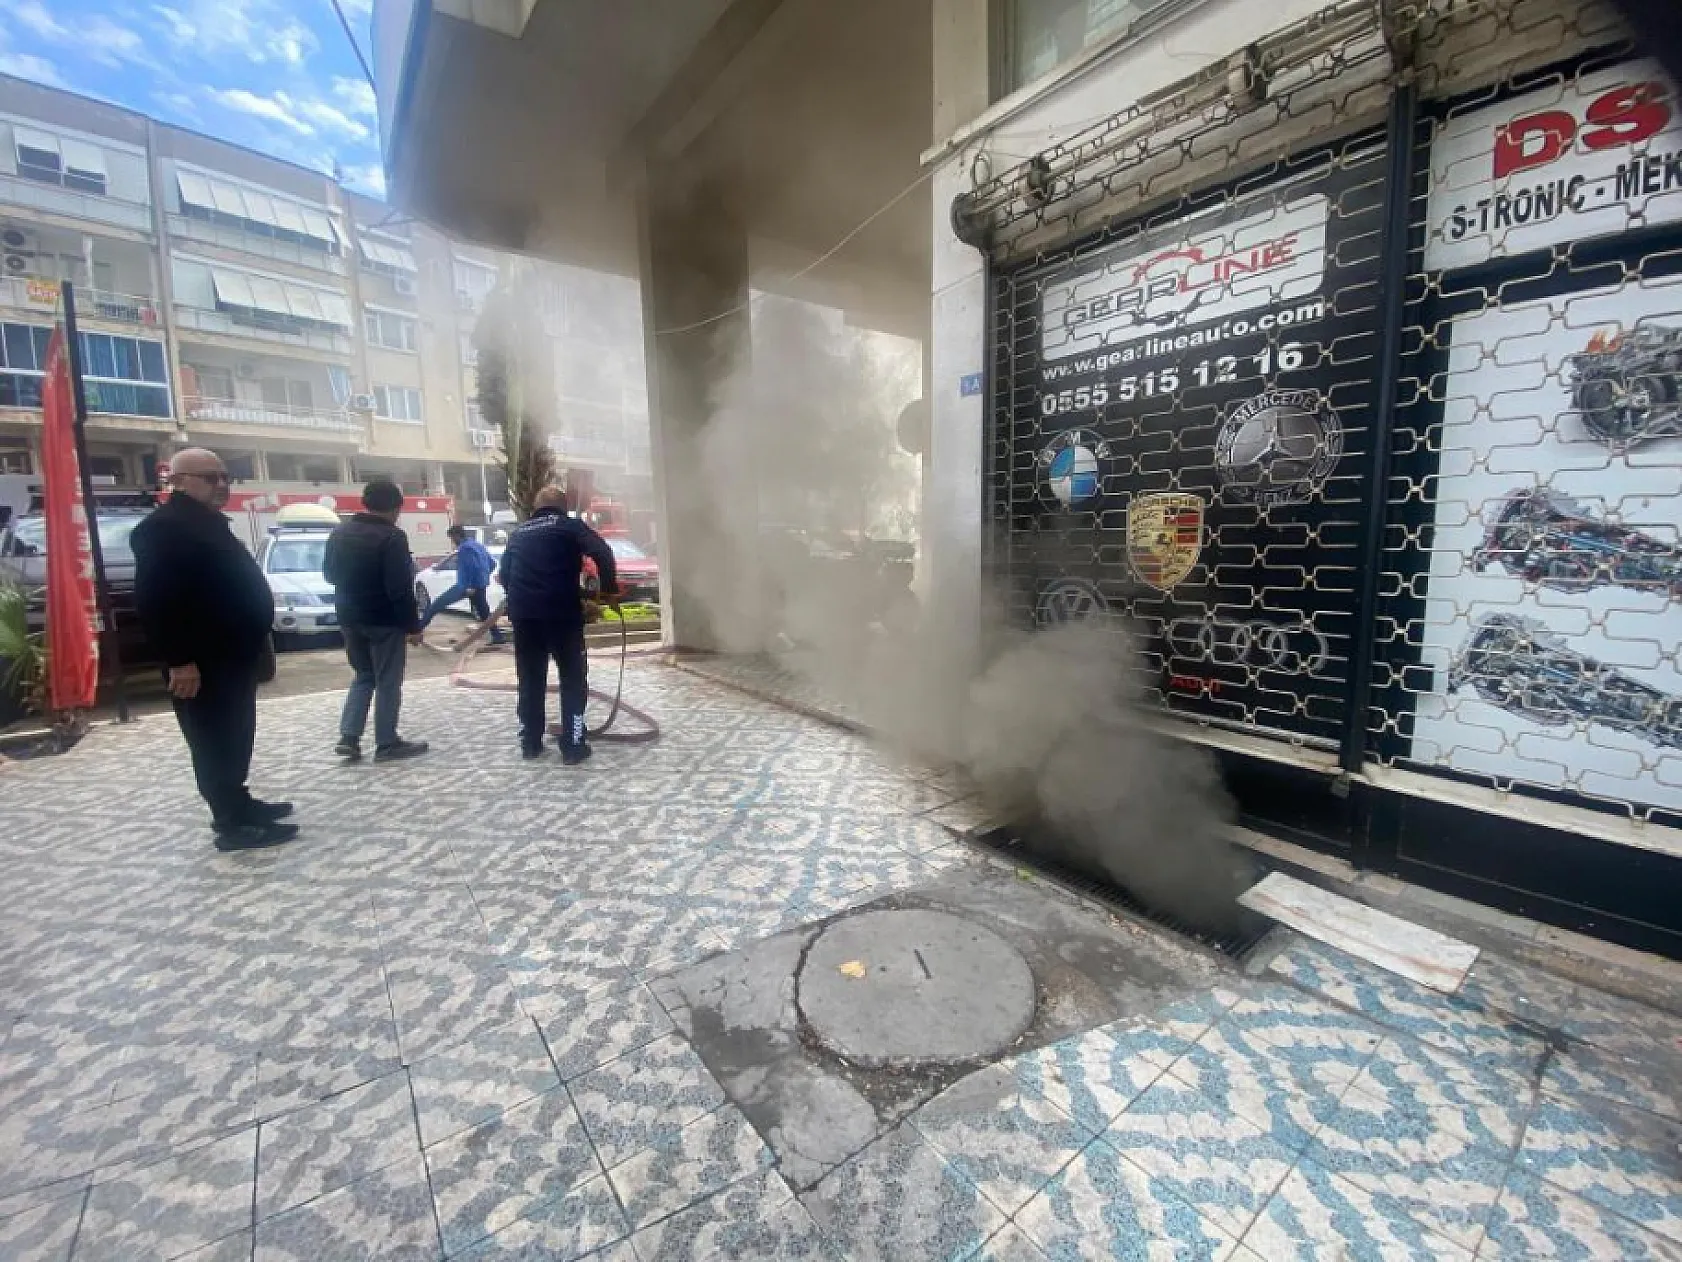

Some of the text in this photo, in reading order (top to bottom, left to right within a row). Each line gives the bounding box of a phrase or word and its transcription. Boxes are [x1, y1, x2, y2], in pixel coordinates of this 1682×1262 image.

[1494, 80, 1672, 180] DS
[1451, 174, 1585, 239] S-TRONIC
[1042, 341, 1304, 415] 0555 515 12 16
